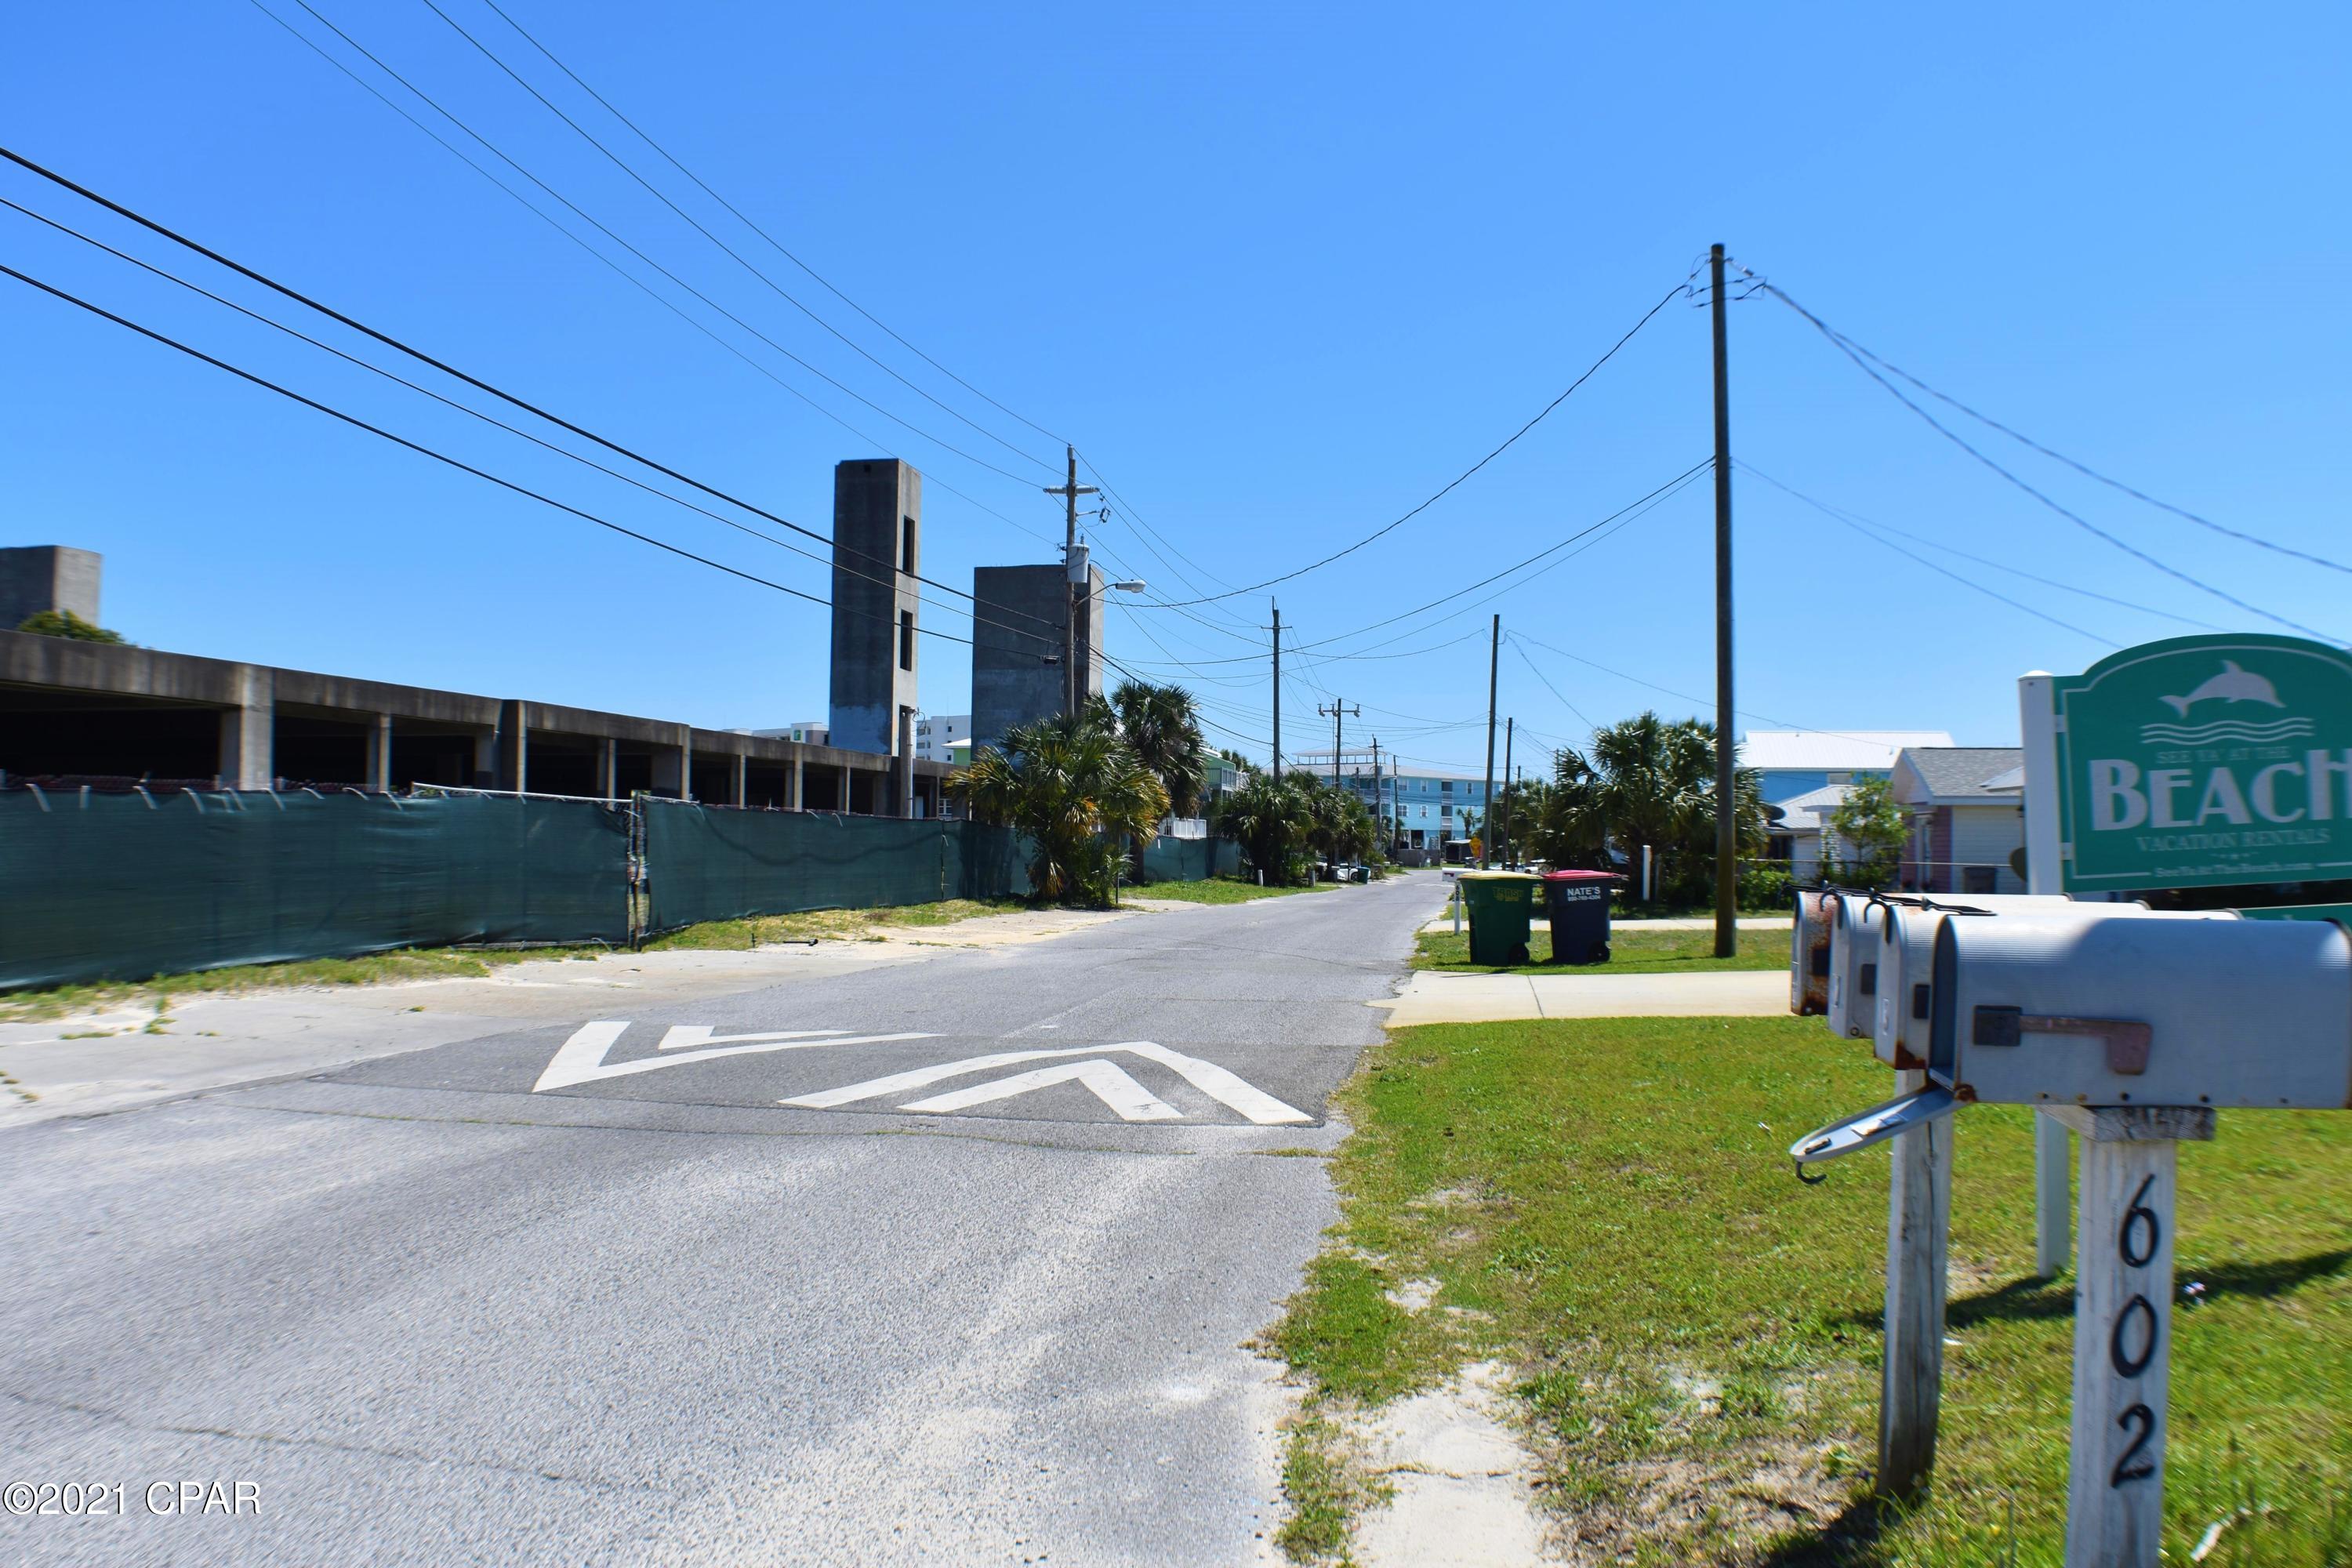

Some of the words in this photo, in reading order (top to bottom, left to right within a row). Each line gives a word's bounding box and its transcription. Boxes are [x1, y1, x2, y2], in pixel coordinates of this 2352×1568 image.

[2089, 748, 2352, 832] BEACH
[2135, 833, 2238, 852] VACATION
[2241, 828, 2331, 848] RENTALS
[1566, 886, 1601, 896] NATE'S
